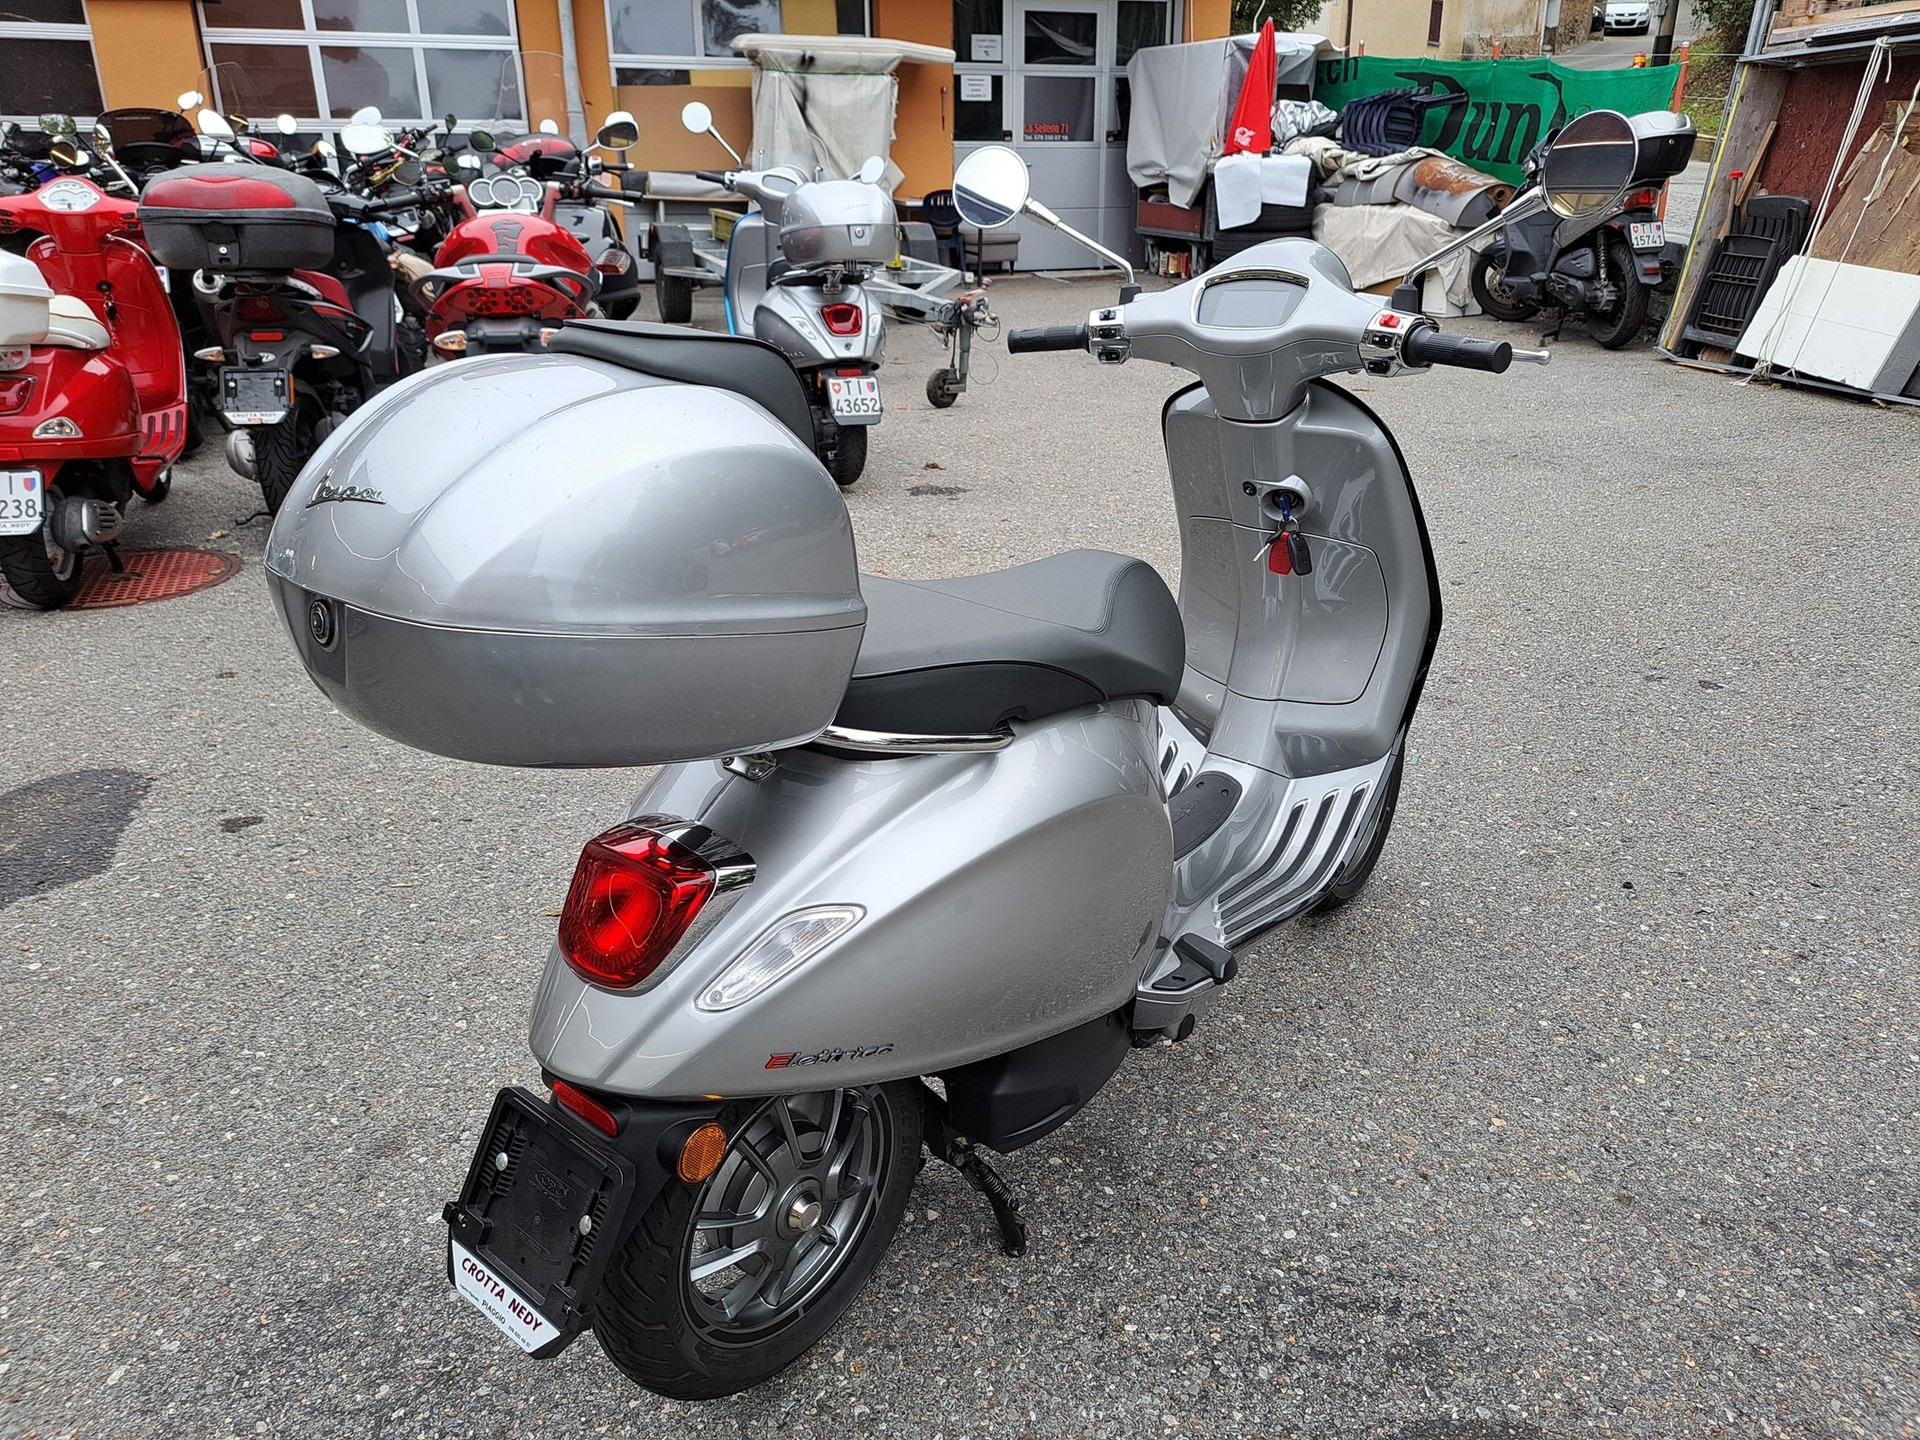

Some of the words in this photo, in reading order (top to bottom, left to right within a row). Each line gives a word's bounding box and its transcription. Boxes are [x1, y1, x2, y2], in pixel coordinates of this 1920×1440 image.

[1024, 123, 1033, 133] La
[1034, 123, 1060, 133] Selleria
[1061, 123, 1069, 133] 71
[1634, 234, 1663, 247] 15741
[844, 380, 862, 395] TI
[835, 398, 878, 414] 43652
[305, 467, 387, 509] Vespa
[0, 498, 37, 519] 238
[764, 1042, 894, 1070] Elettrica
[461, 1257, 506, 1303] CROTTA
[508, 1297, 543, 1332] NEDY
[481, 1299, 506, 1325] PIAGGIO
